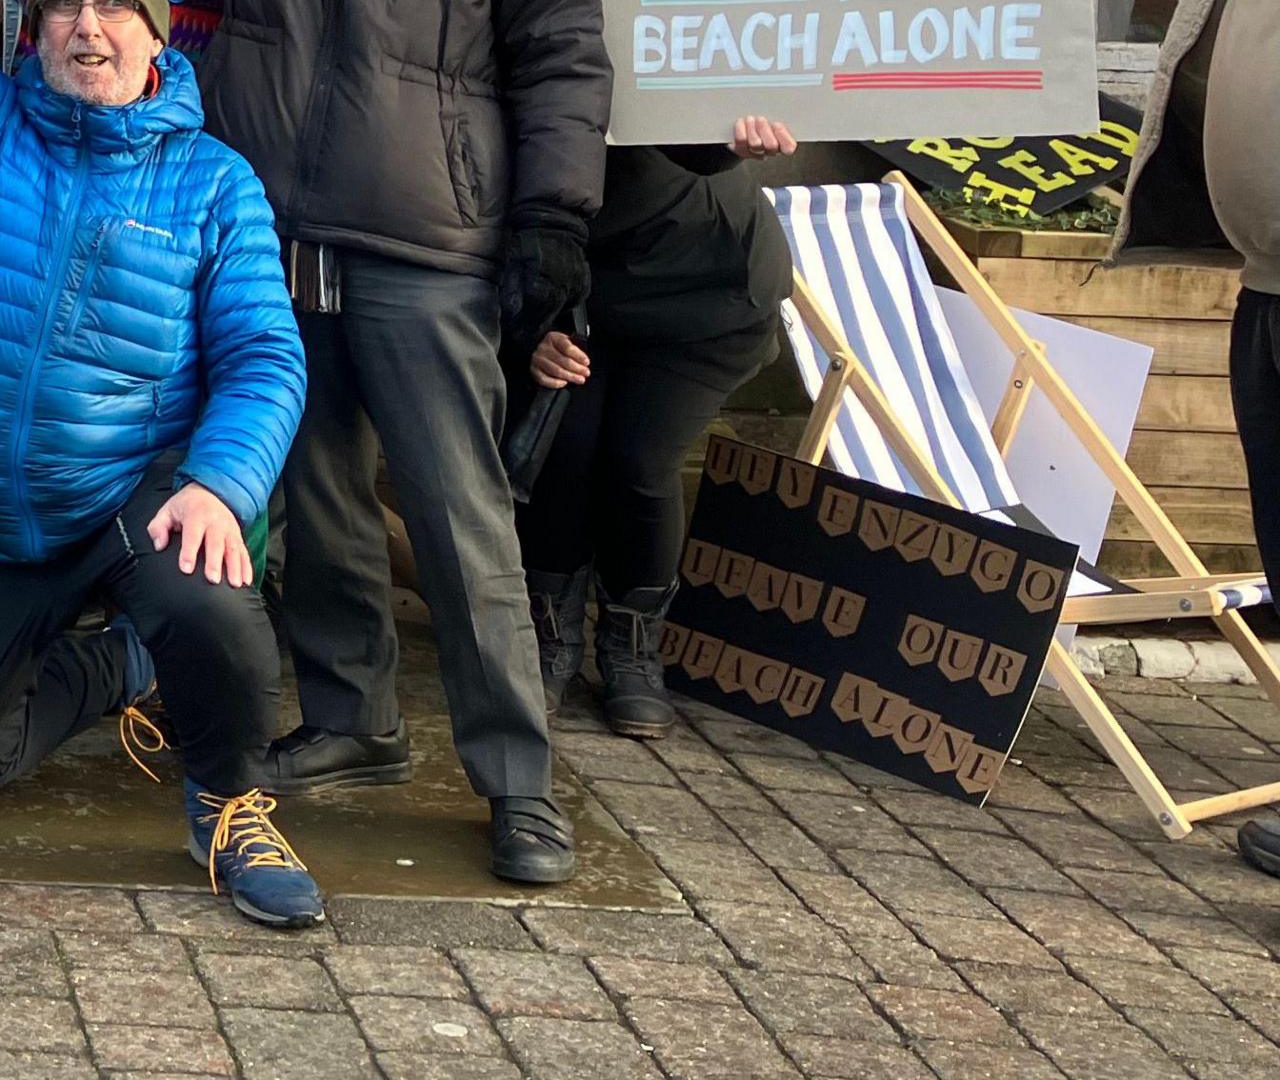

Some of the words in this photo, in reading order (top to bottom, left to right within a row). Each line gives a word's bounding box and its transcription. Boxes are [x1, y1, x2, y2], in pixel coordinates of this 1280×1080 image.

[634, 12, 821, 73] BEACH
[830, 2, 1043, 67] ALONE
[709, 441, 813, 498] HEY
[827, 494, 1055, 603] ENZYGO
[689, 546, 857, 628] LEAVE
[905, 623, 1014, 687] OUR
[657, 627, 820, 708] BEACH
[841, 683, 997, 785] ALONE
